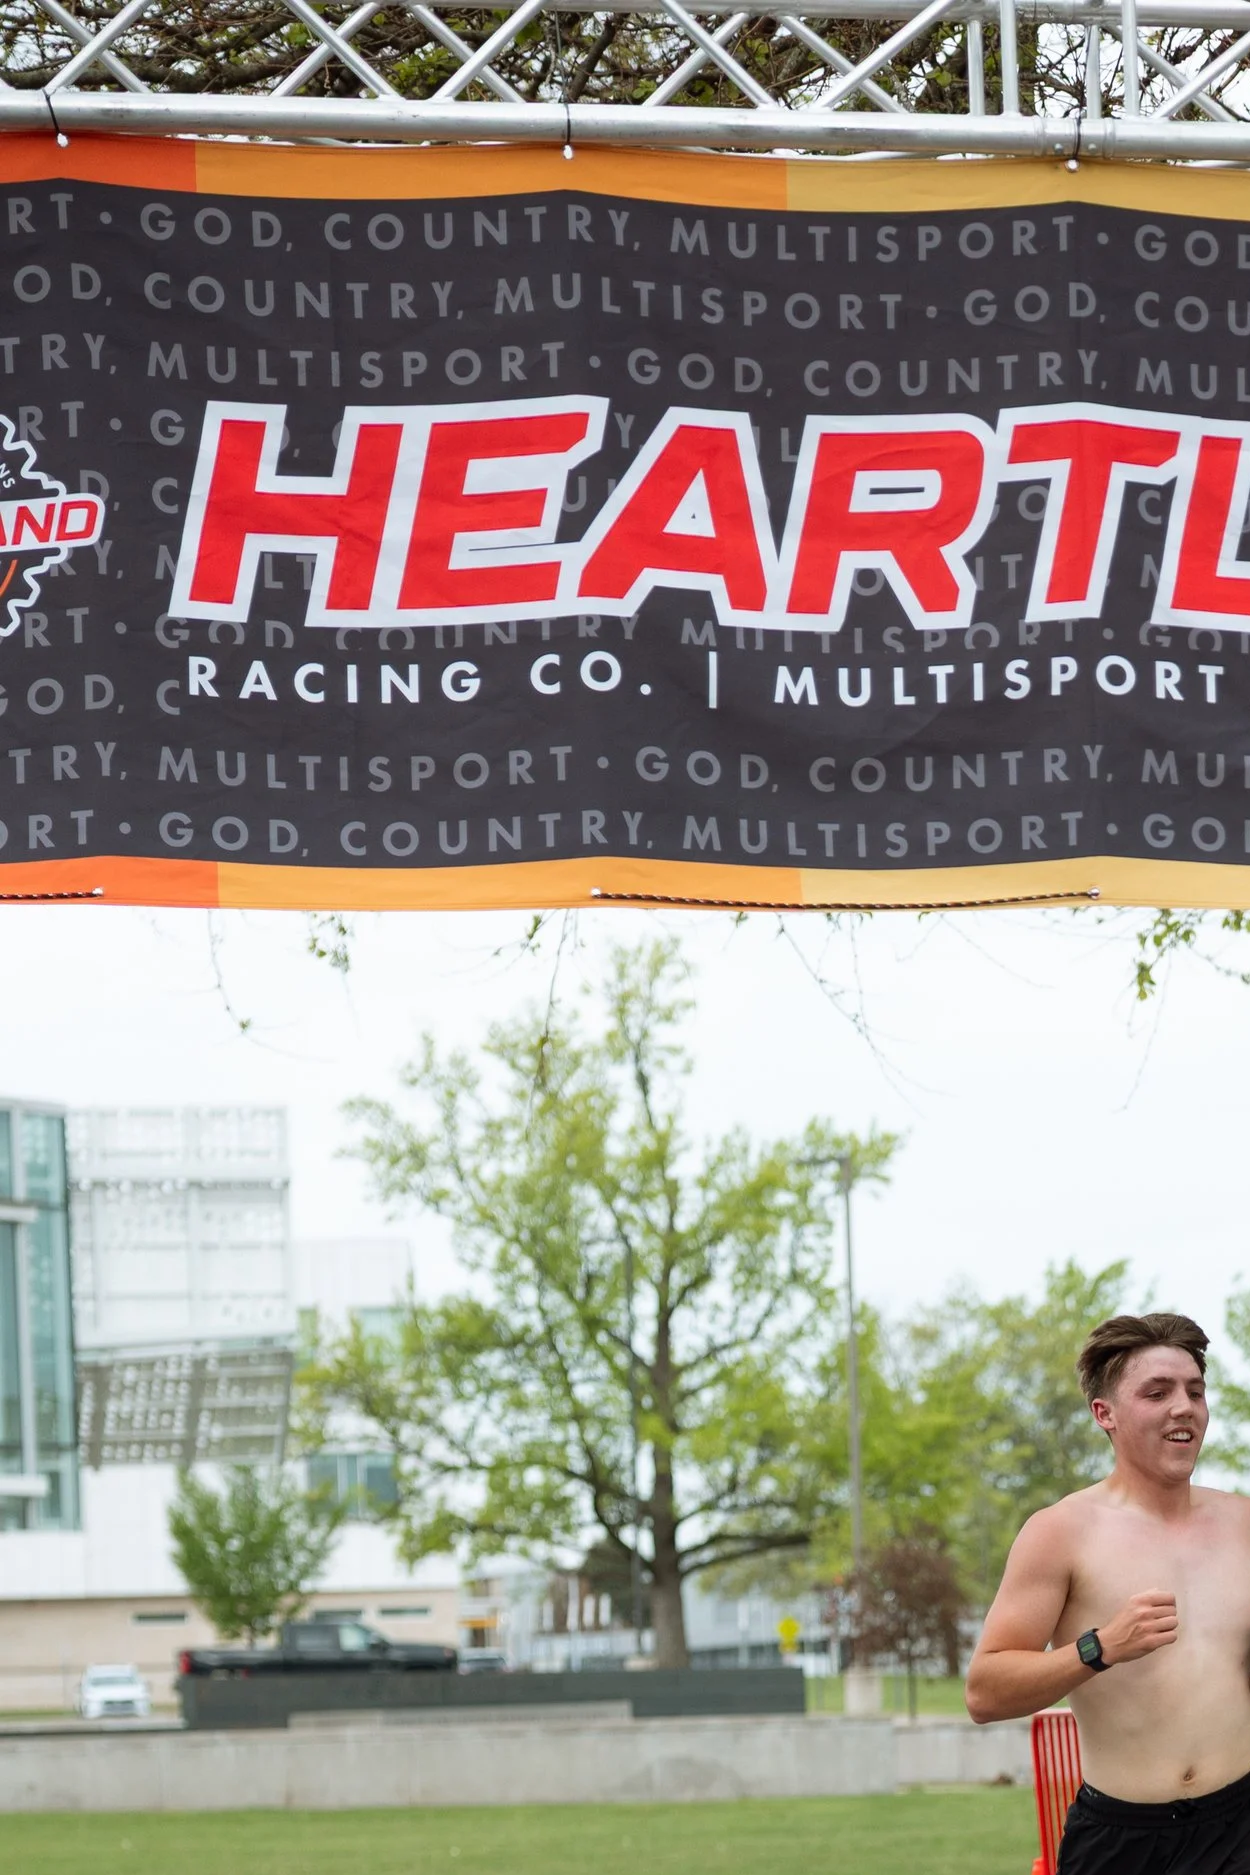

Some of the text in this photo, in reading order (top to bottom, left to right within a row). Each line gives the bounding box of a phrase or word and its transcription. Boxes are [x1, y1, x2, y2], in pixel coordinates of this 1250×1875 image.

[140, 203, 292, 252] GOD,
[324, 204, 640, 251] COUNTRY,
[670, 215, 1074, 263] MULTISPORT
[144, 272, 463, 320] COUNTRY,
[494, 273, 902, 330] MULTISPORT
[963, 282, 1106, 326] GOD,
[147, 341, 565, 388] MULTISPORT
[627, 348, 772, 397] GOD,
[804, 349, 1107, 397] COUNTRY,
[188, 655, 481, 704] RACING
[530, 650, 652, 696] CO.
[774, 655, 1224, 707] MULTISPORT
[157, 745, 572, 792] MULTISPORT
[635, 746, 778, 792] GOD,
[809, 745, 1113, 793] COUNTRY,
[159, 812, 308, 857] GOD,
[340, 809, 653, 856] COUNTRY,
[682, 811, 1084, 858] MULTISPORT
